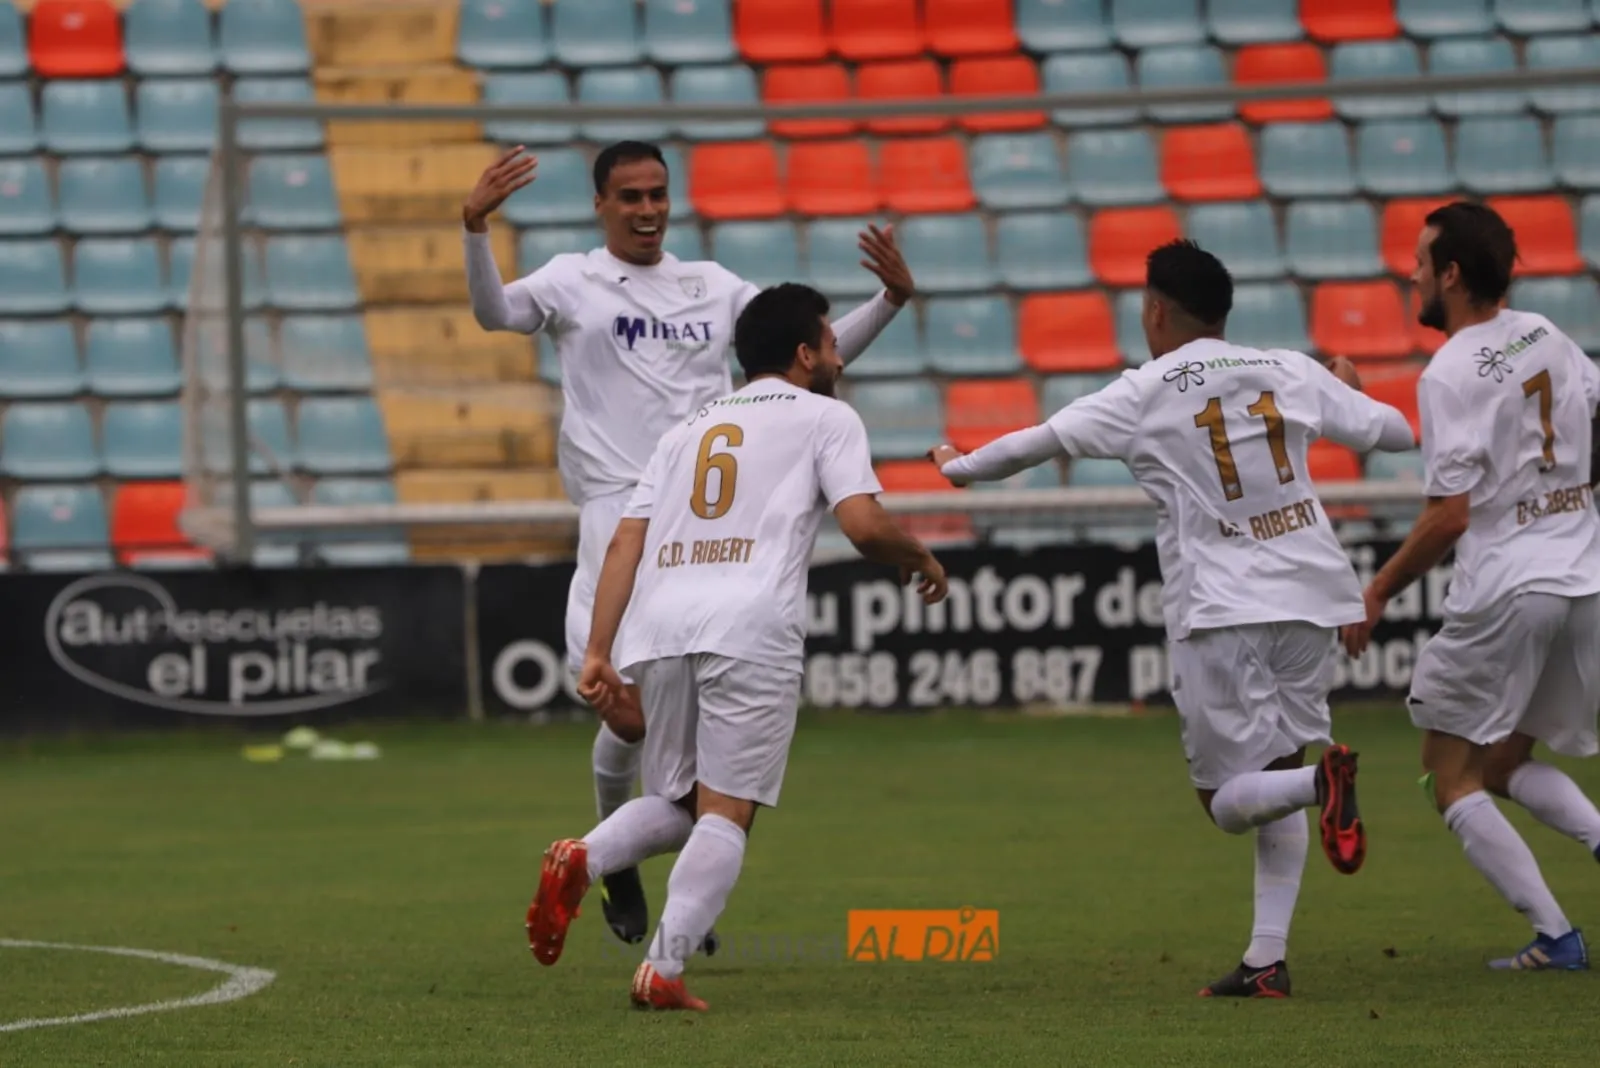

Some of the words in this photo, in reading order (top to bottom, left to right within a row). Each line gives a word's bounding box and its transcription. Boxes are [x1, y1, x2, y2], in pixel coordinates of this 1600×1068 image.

[720, 393, 797, 407] vitaterra
[1522, 369, 1556, 473] 7
[690, 423, 744, 519] 6
[1194, 391, 1295, 501] 11
[1249, 499, 1317, 540] RIBERT
[658, 542, 685, 568] C.D.
[690, 539, 755, 564] RIBERT
[853, 566, 1085, 650] pintor
[148, 645, 206, 695] el
[229, 641, 379, 705] pilar
[808, 653, 898, 707] 658
[909, 651, 1000, 705] 246
